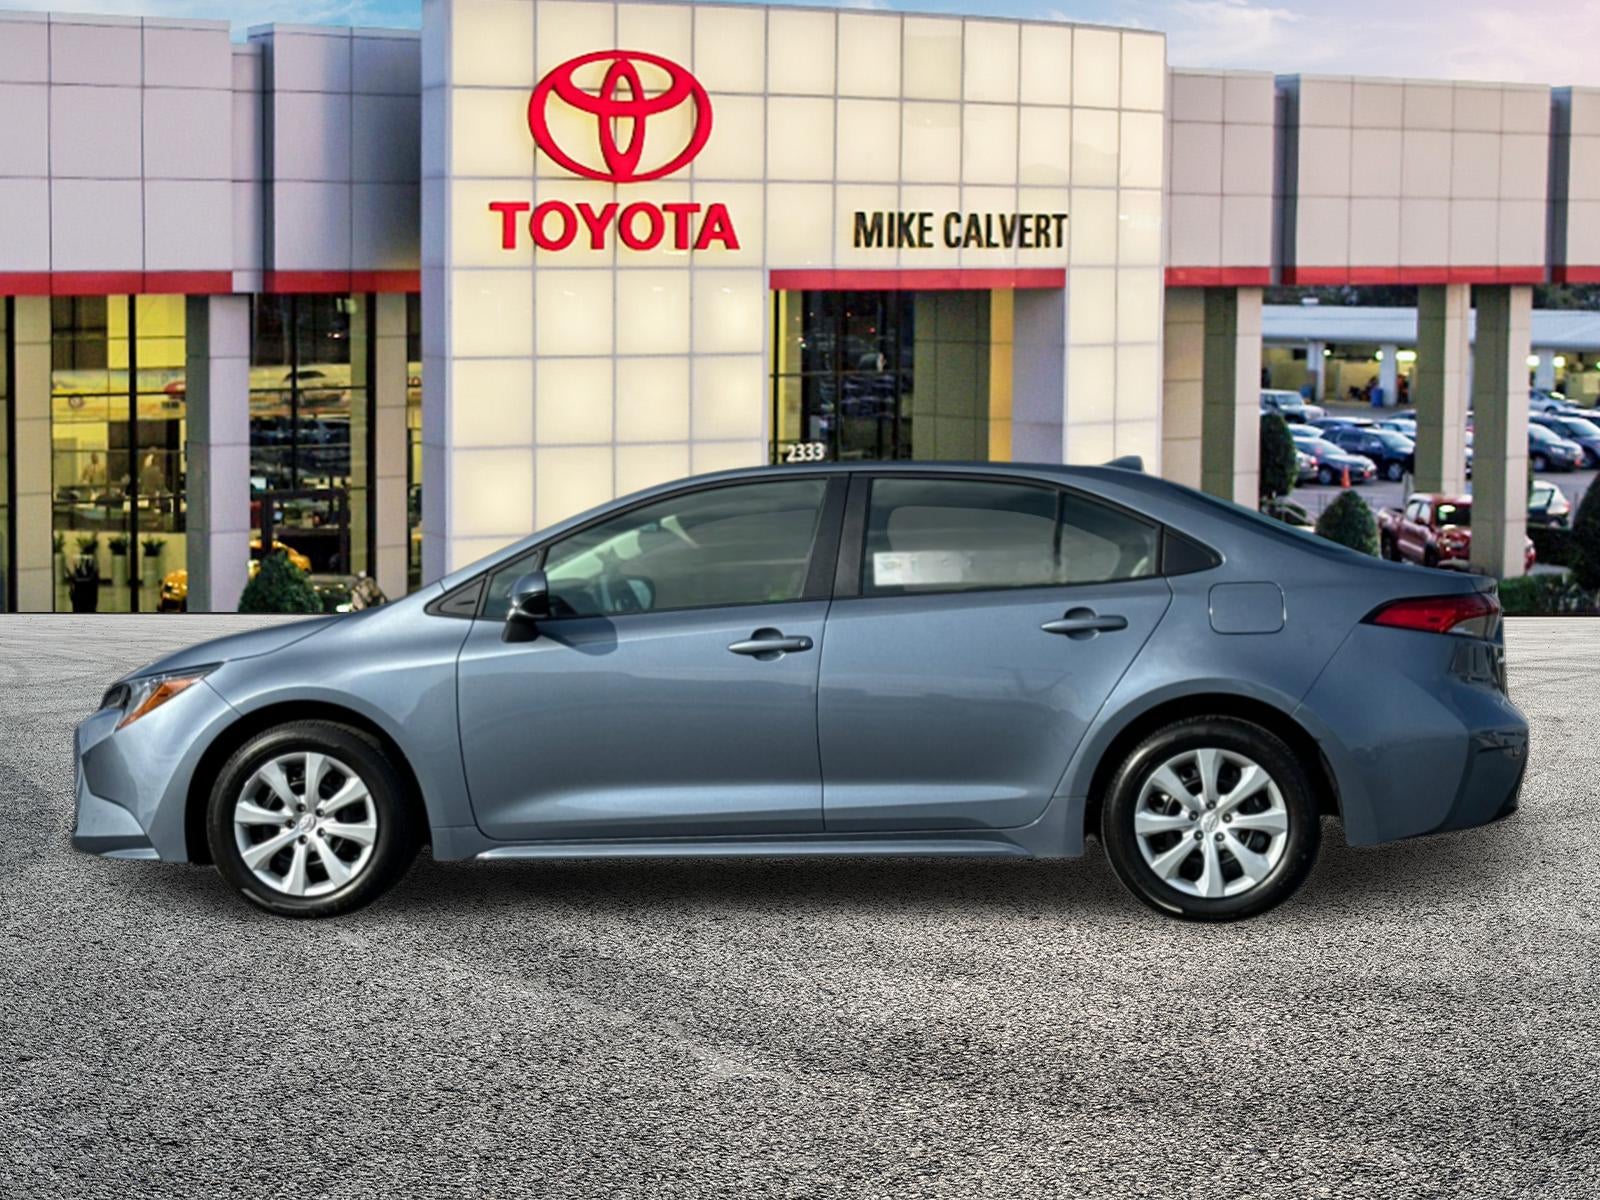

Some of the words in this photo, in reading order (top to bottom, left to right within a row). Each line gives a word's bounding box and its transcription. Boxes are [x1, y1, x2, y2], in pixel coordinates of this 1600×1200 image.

[489, 201, 740, 250] TOYOTA
[854, 212, 934, 249] MIKE
[943, 212, 1068, 249] CALVERT
[786, 442, 825, 462] 2333
